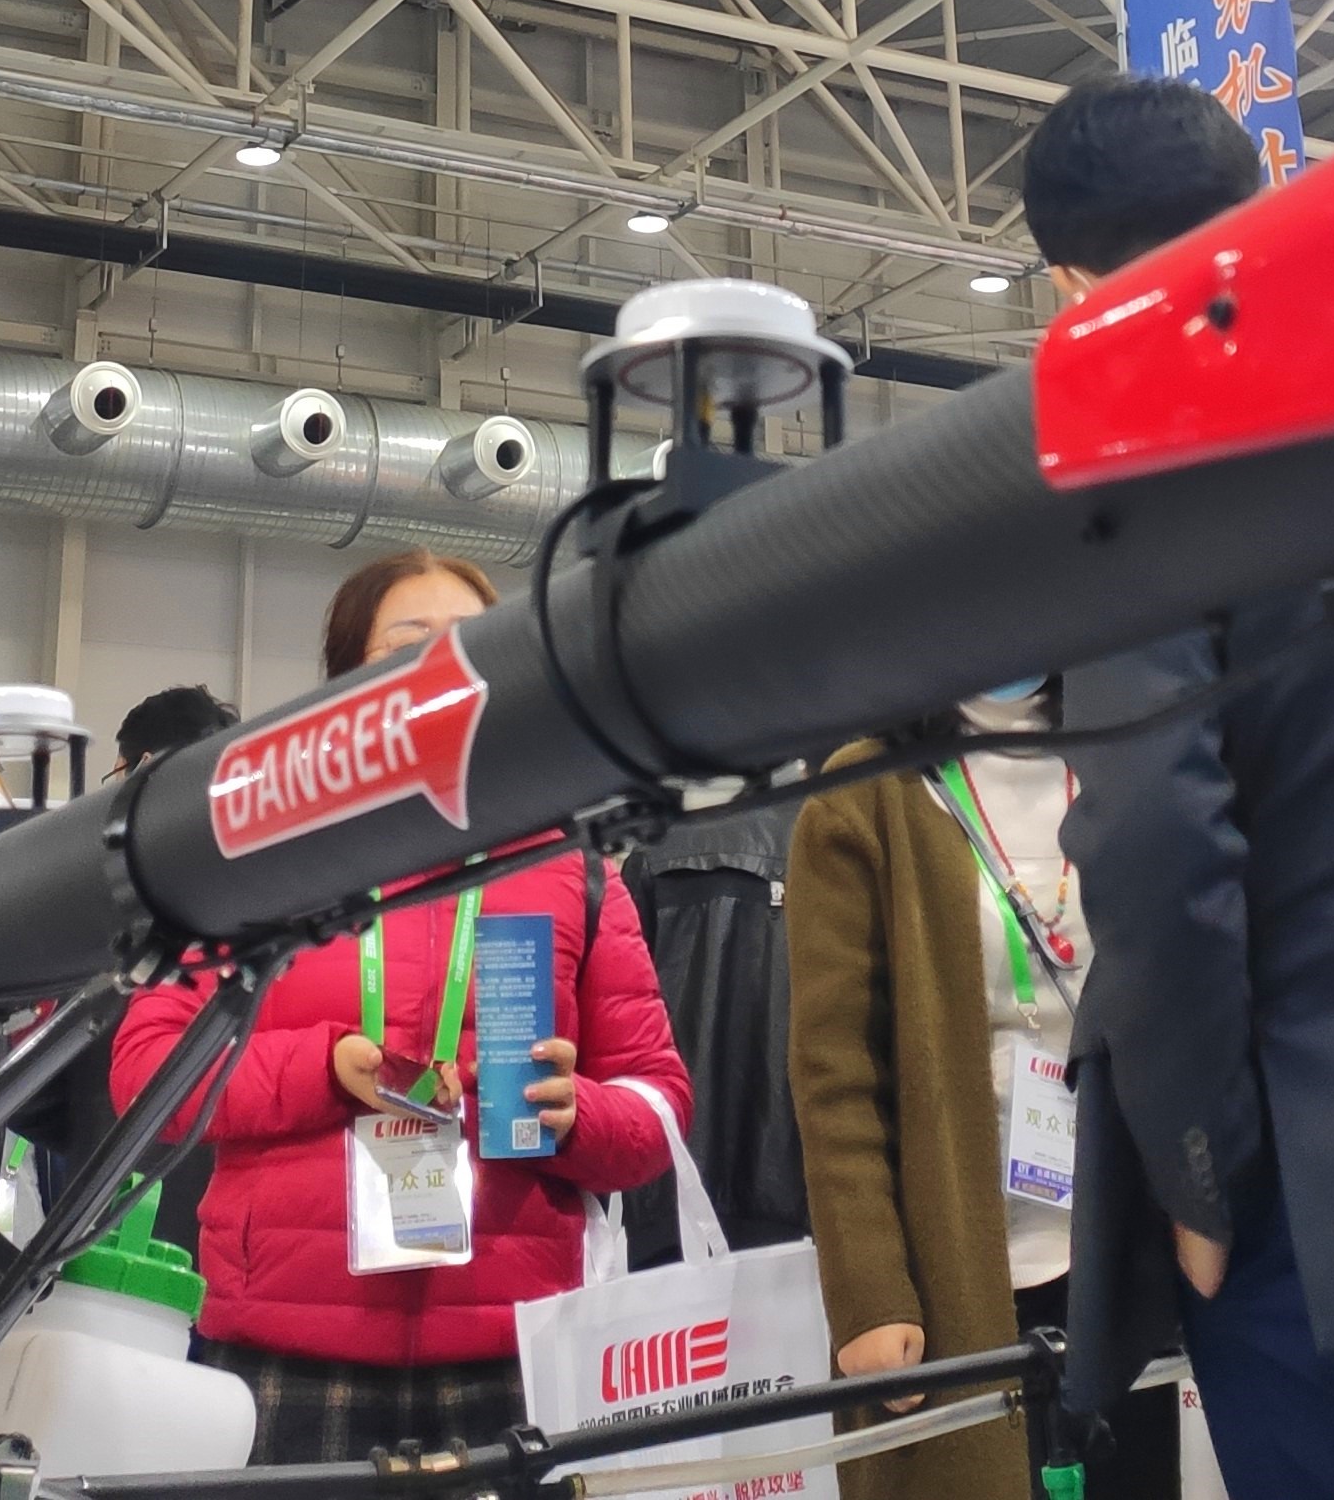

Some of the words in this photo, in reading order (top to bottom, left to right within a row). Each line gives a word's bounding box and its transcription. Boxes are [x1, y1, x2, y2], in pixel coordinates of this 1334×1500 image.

[1161, 17, 1202, 88] 临
[224, 687, 419, 831] DANGER
[387, 1168, 445, 1193] 众证
